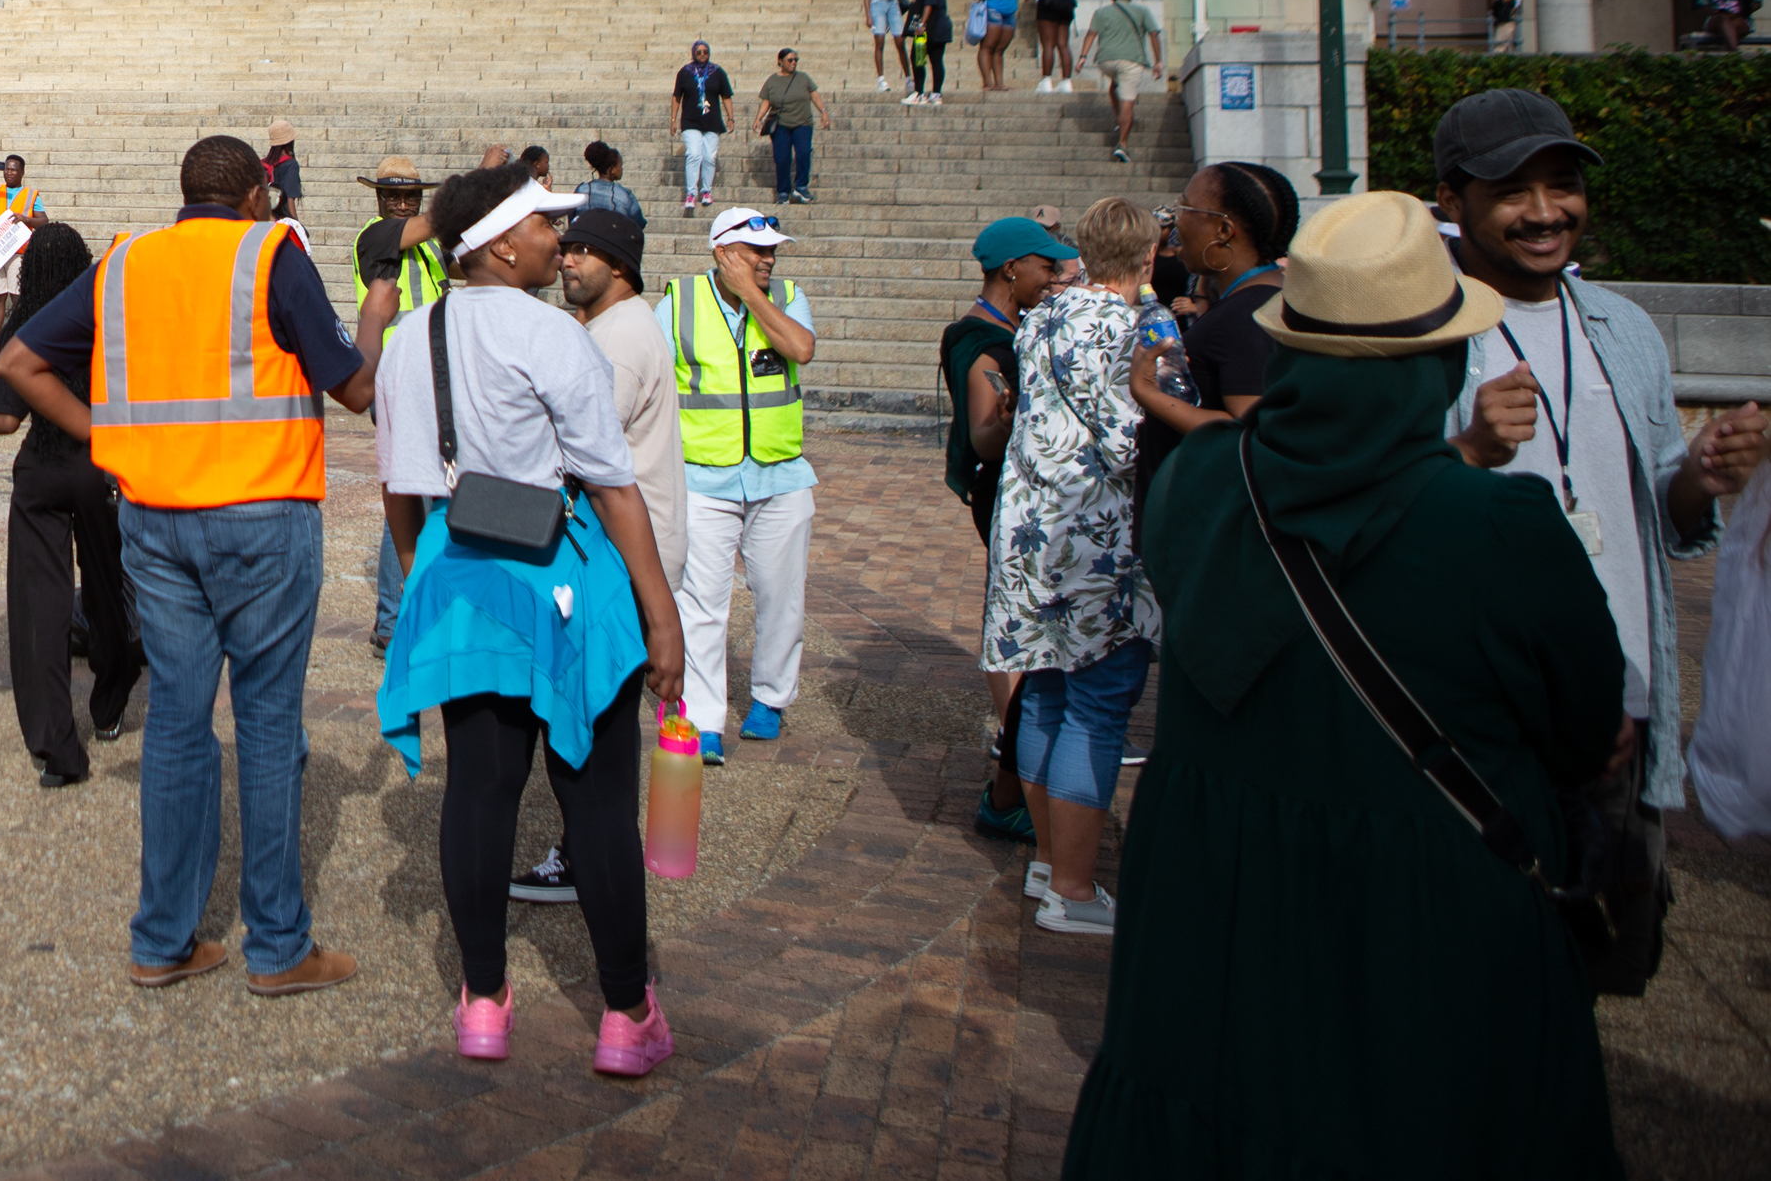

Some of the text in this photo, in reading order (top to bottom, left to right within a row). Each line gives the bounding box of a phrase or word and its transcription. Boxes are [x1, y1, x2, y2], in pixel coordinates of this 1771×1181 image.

[0, 235, 18, 256] EXERCISE!
[2, 233, 13, 242] TICK
[432, 346, 447, 390] ROAD
